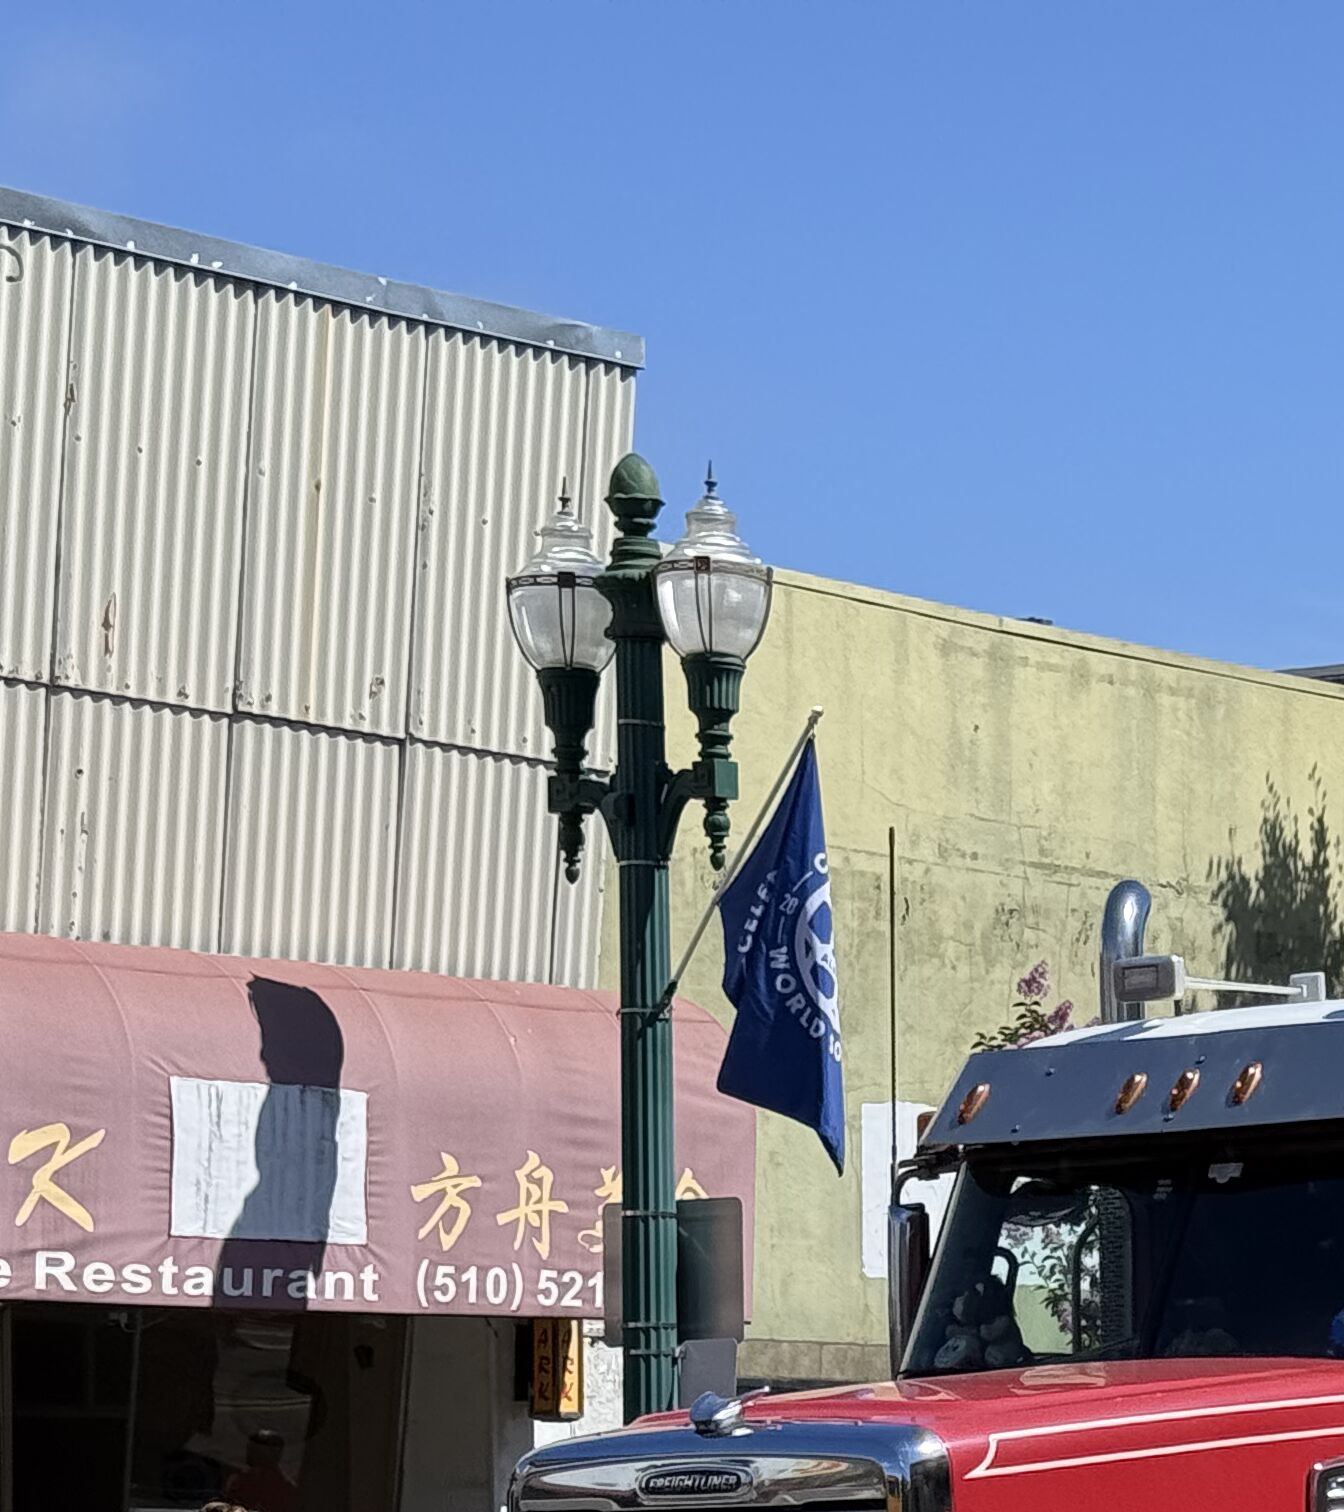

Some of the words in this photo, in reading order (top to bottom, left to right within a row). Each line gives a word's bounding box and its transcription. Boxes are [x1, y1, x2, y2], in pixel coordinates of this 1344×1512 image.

[769, 945, 826, 1038] WORLD
[35, 1251, 380, 1302] Restaurant
[416, 1258, 523, 1311] (510)
[649, 1474, 739, 1490] FREIGHTLINER
